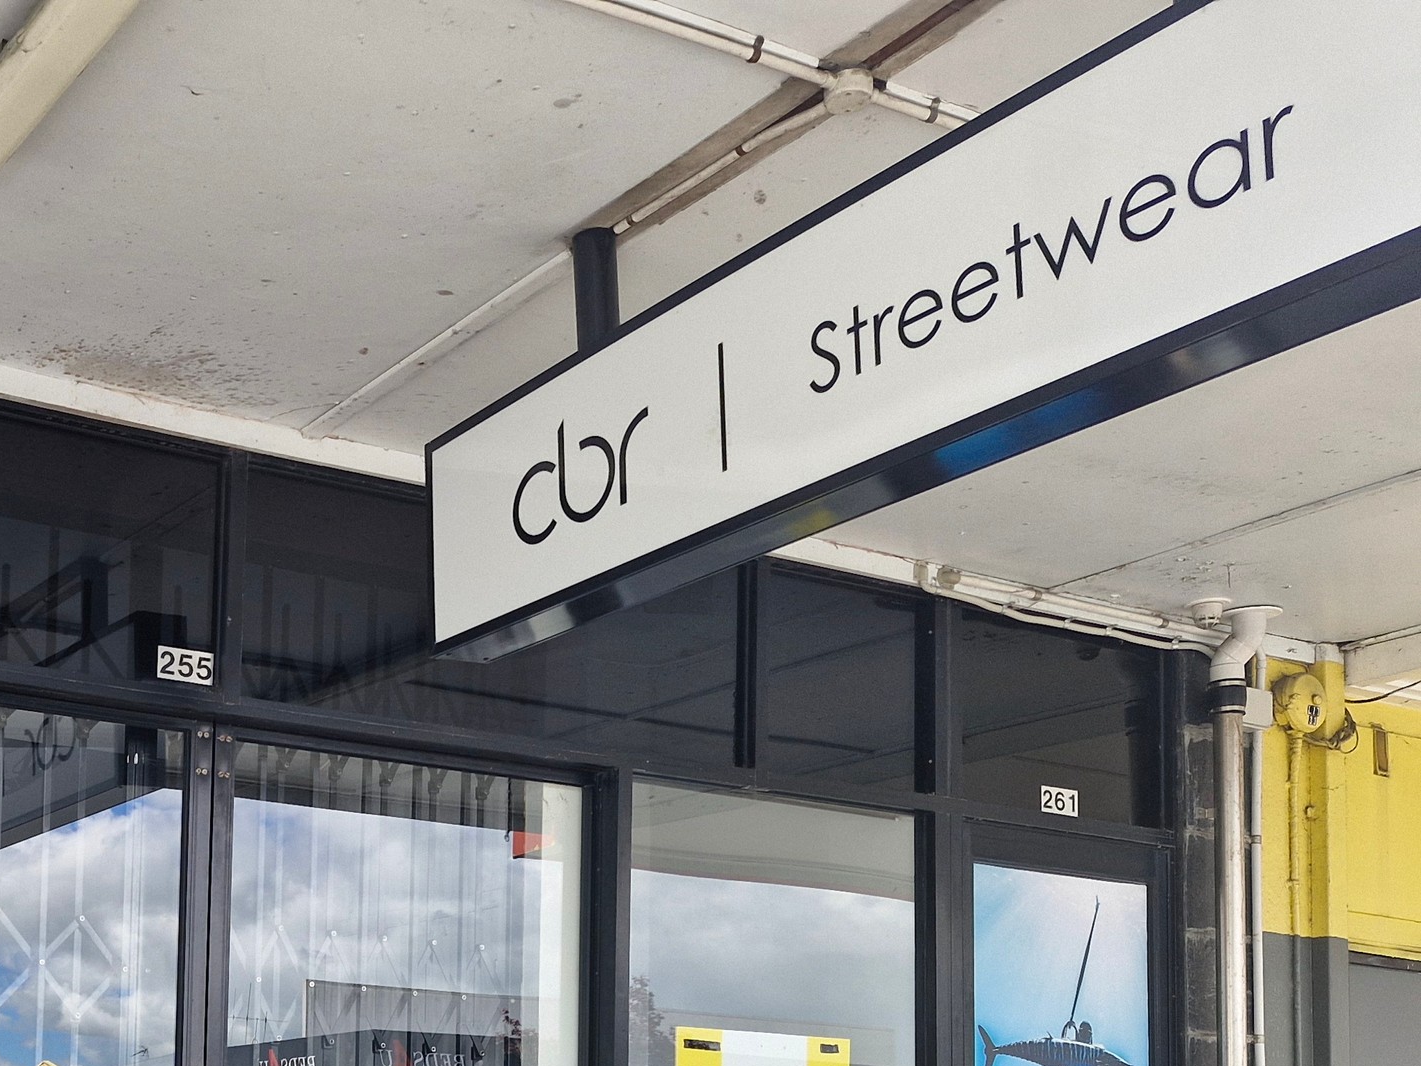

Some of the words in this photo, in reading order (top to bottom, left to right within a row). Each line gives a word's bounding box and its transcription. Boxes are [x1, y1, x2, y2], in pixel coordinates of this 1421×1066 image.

[513, 405, 648, 545] cbr
[809, 104, 1295, 393] Streetwear
[160, 650, 212, 680] 255
[1043, 790, 1075, 812] 261
